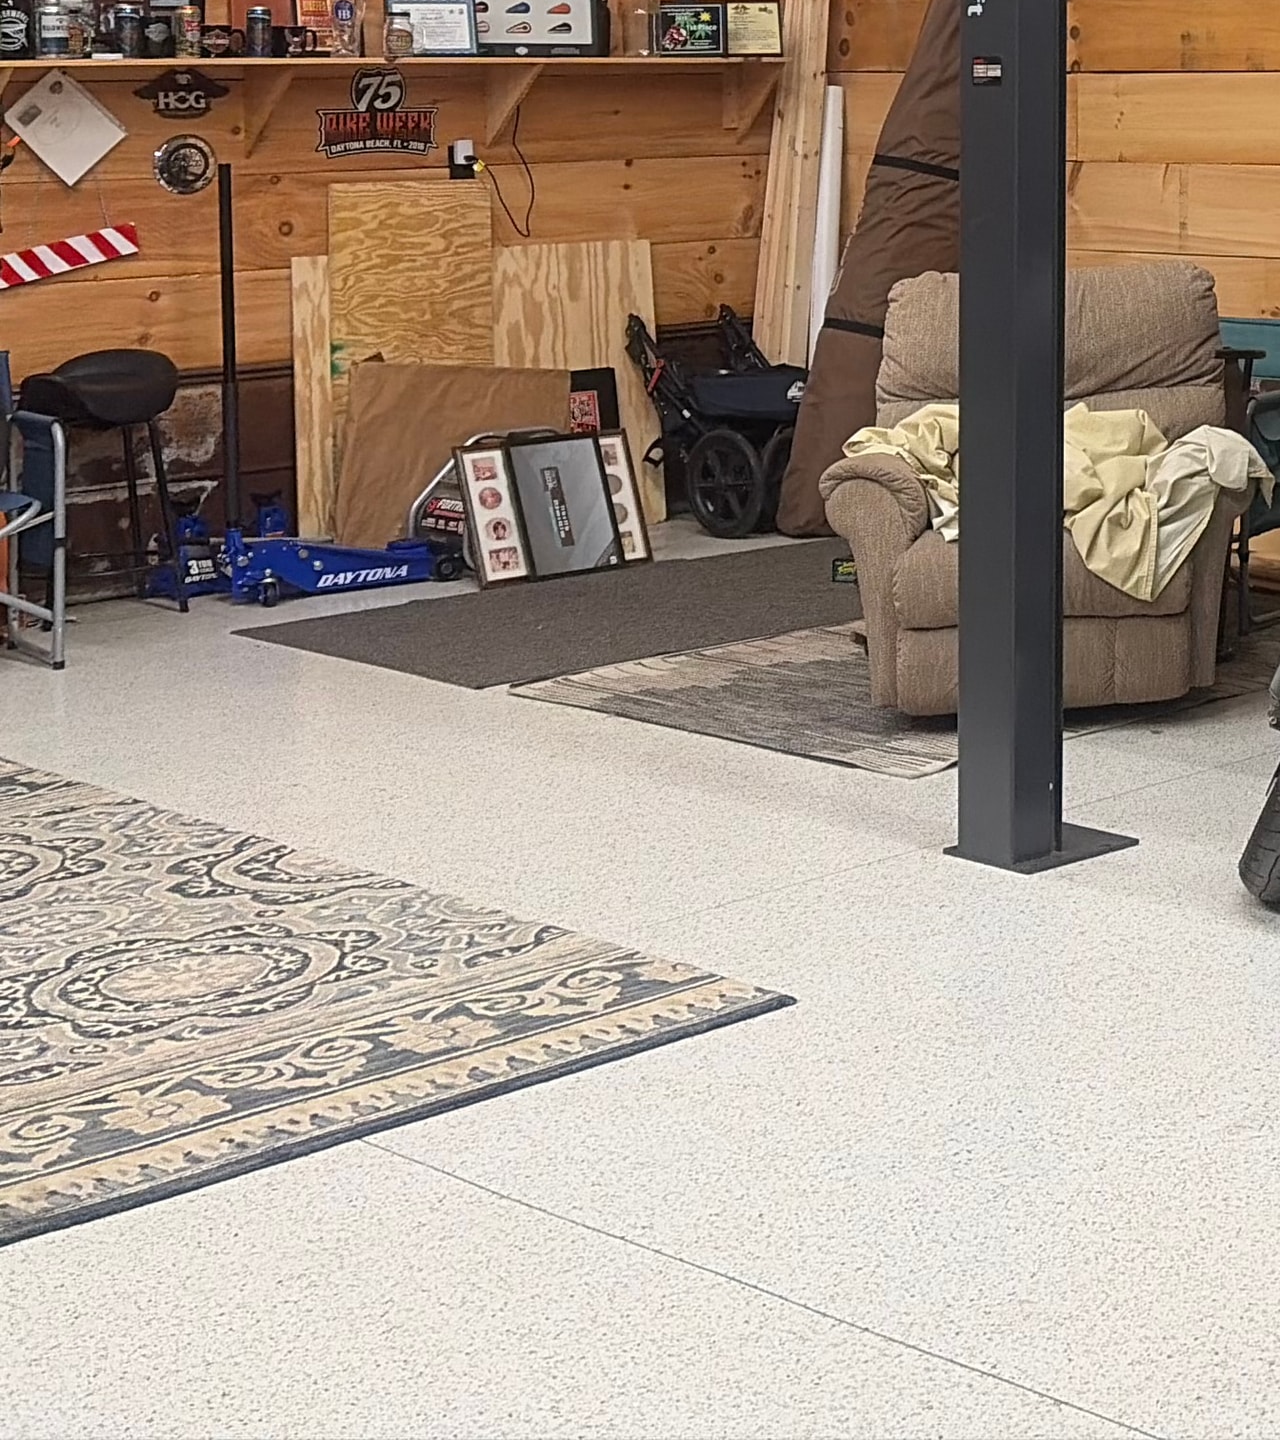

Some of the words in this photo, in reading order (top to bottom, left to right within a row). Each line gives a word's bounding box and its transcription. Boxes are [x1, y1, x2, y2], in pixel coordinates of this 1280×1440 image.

[158, 91, 207, 109] HOG
[358, 73, 401, 112] 75
[325, 112, 370, 139] BIKE
[376, 112, 432, 139] WEEK
[330, 141, 365, 153] DAYTONA
[187, 560, 197, 575] 3
[316, 564, 409, 588] DAYTONA
